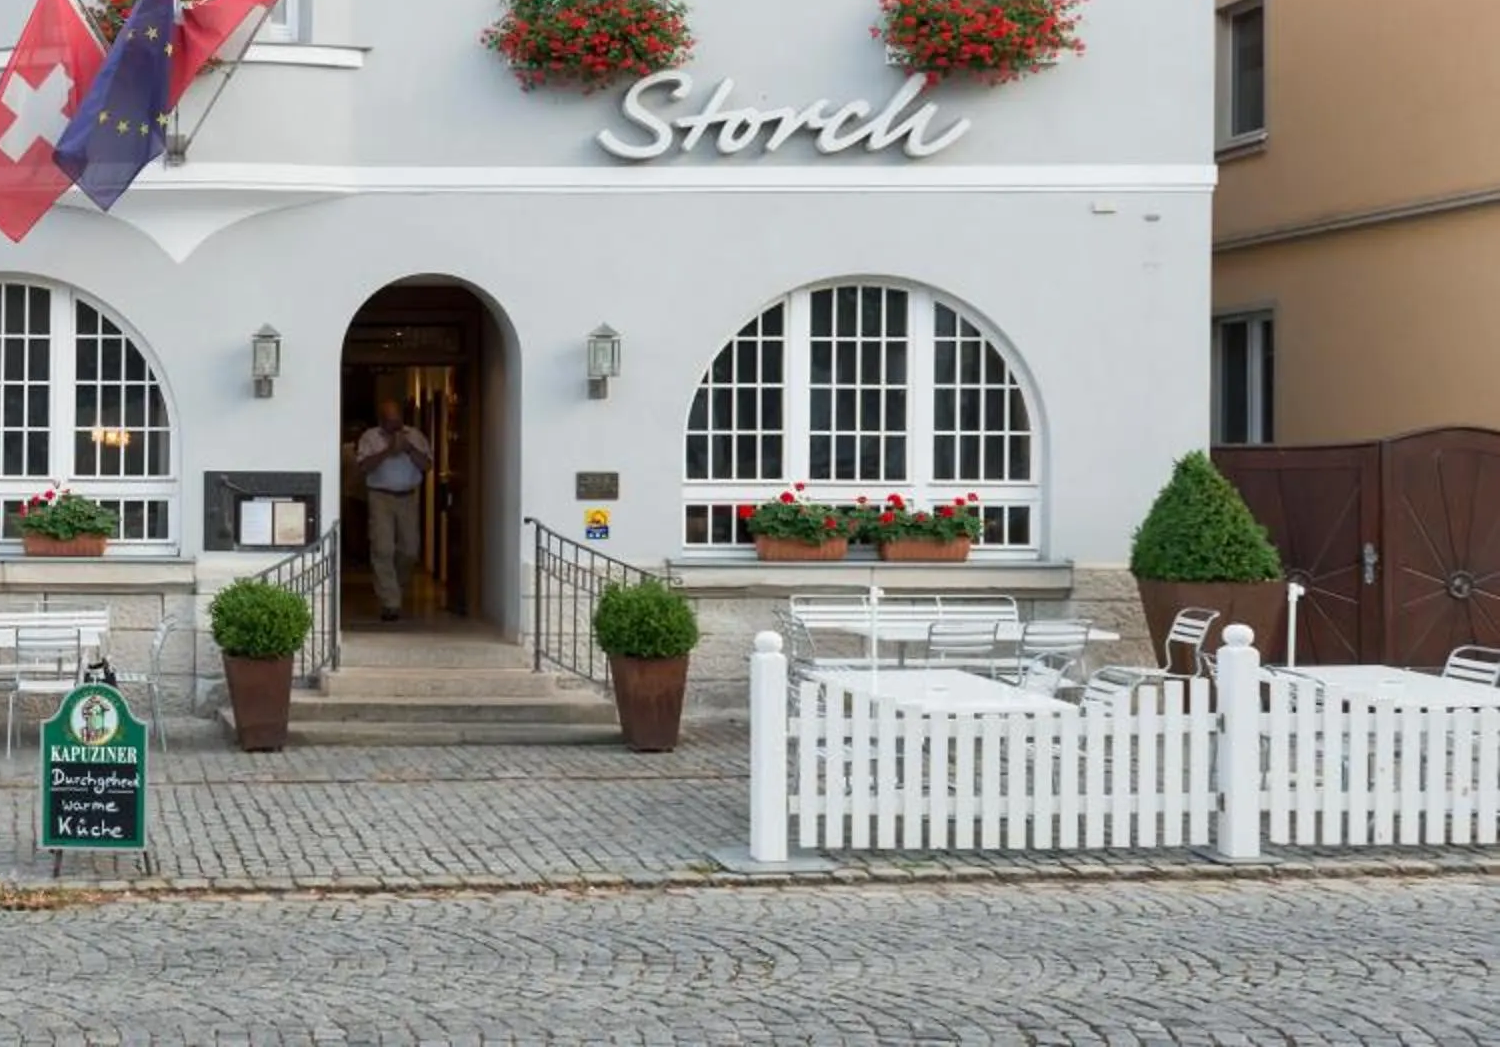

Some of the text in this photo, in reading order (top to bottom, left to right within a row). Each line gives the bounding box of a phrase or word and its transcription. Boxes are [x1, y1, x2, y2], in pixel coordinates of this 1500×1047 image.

[598, 69, 972, 159] Storch
[51, 745, 137, 763] KAPUZINER
[62, 799, 119, 813] warme
[59, 816, 124, 838] Küche
